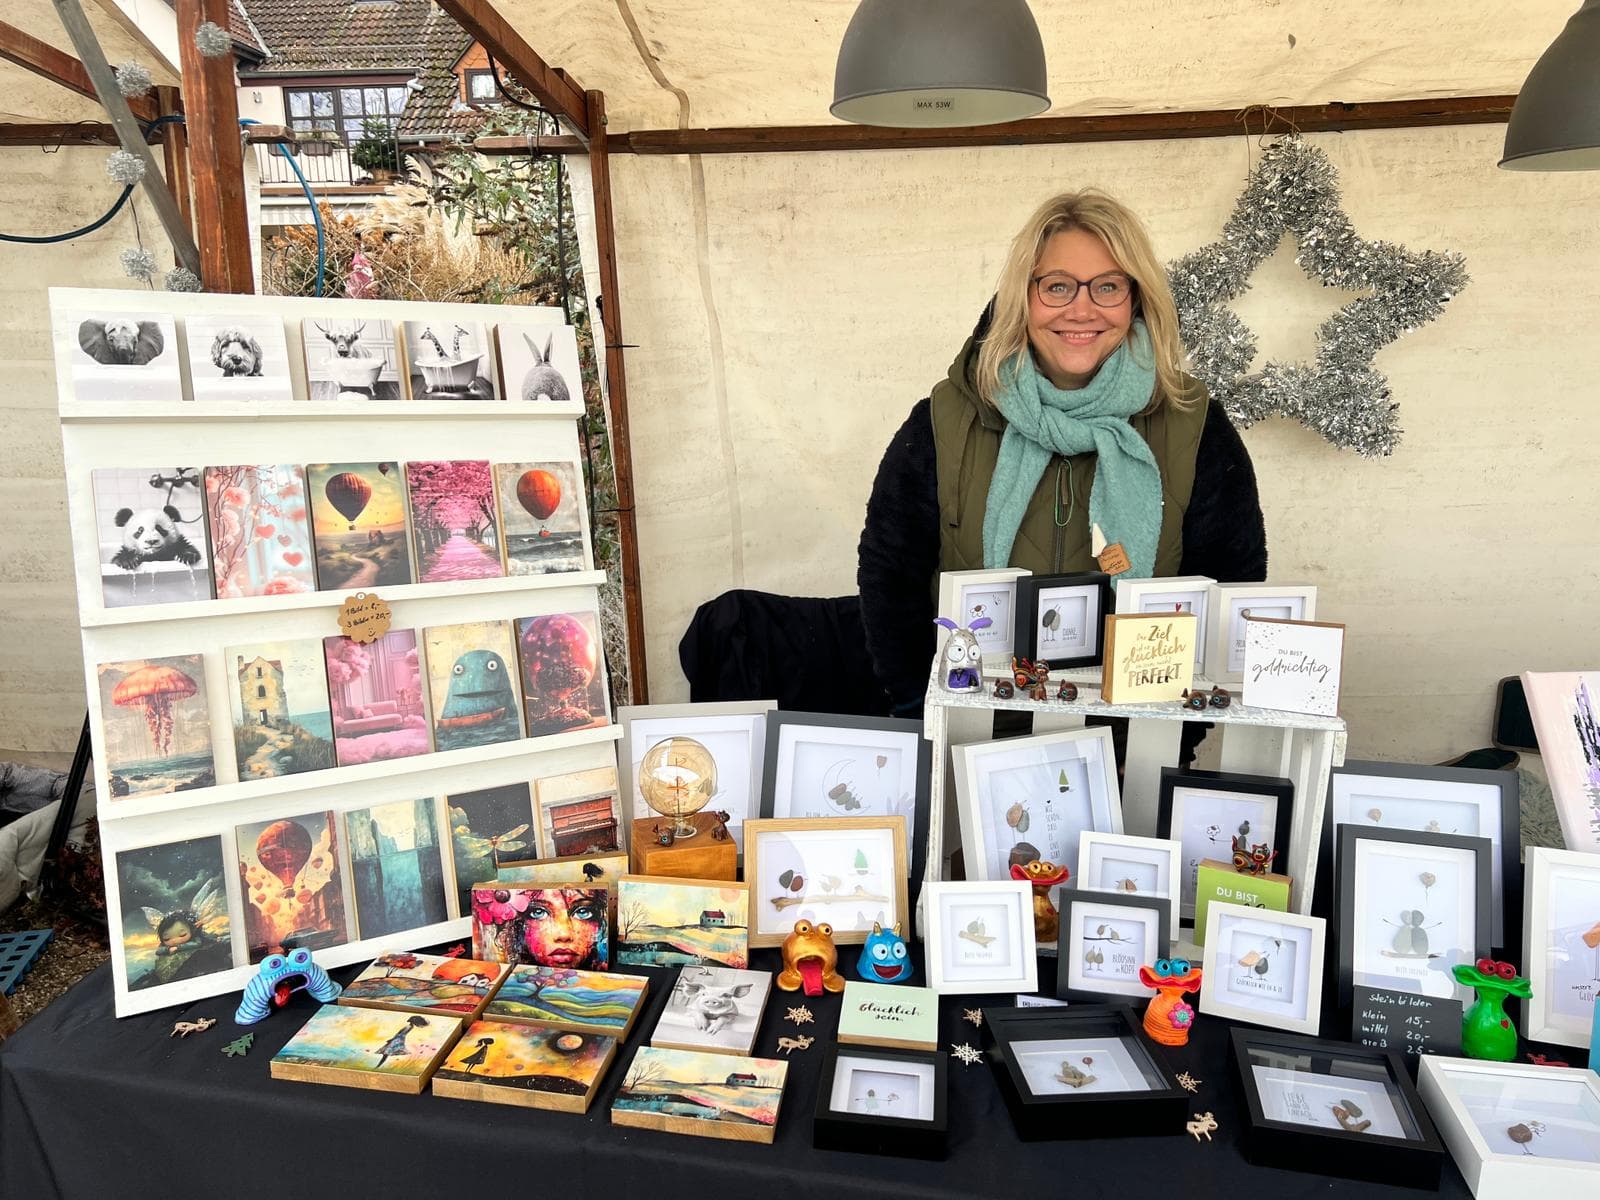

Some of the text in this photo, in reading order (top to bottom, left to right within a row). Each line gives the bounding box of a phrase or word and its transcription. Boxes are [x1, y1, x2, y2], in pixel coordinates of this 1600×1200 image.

[1148, 623, 1173, 641] Ziel
[1123, 636, 1186, 673] glücklich
[1252, 655, 1331, 683] goldrichtig
[1216, 886, 1258, 904] DU BIST
[1362, 1024, 1431, 1042] mittel 20,-
